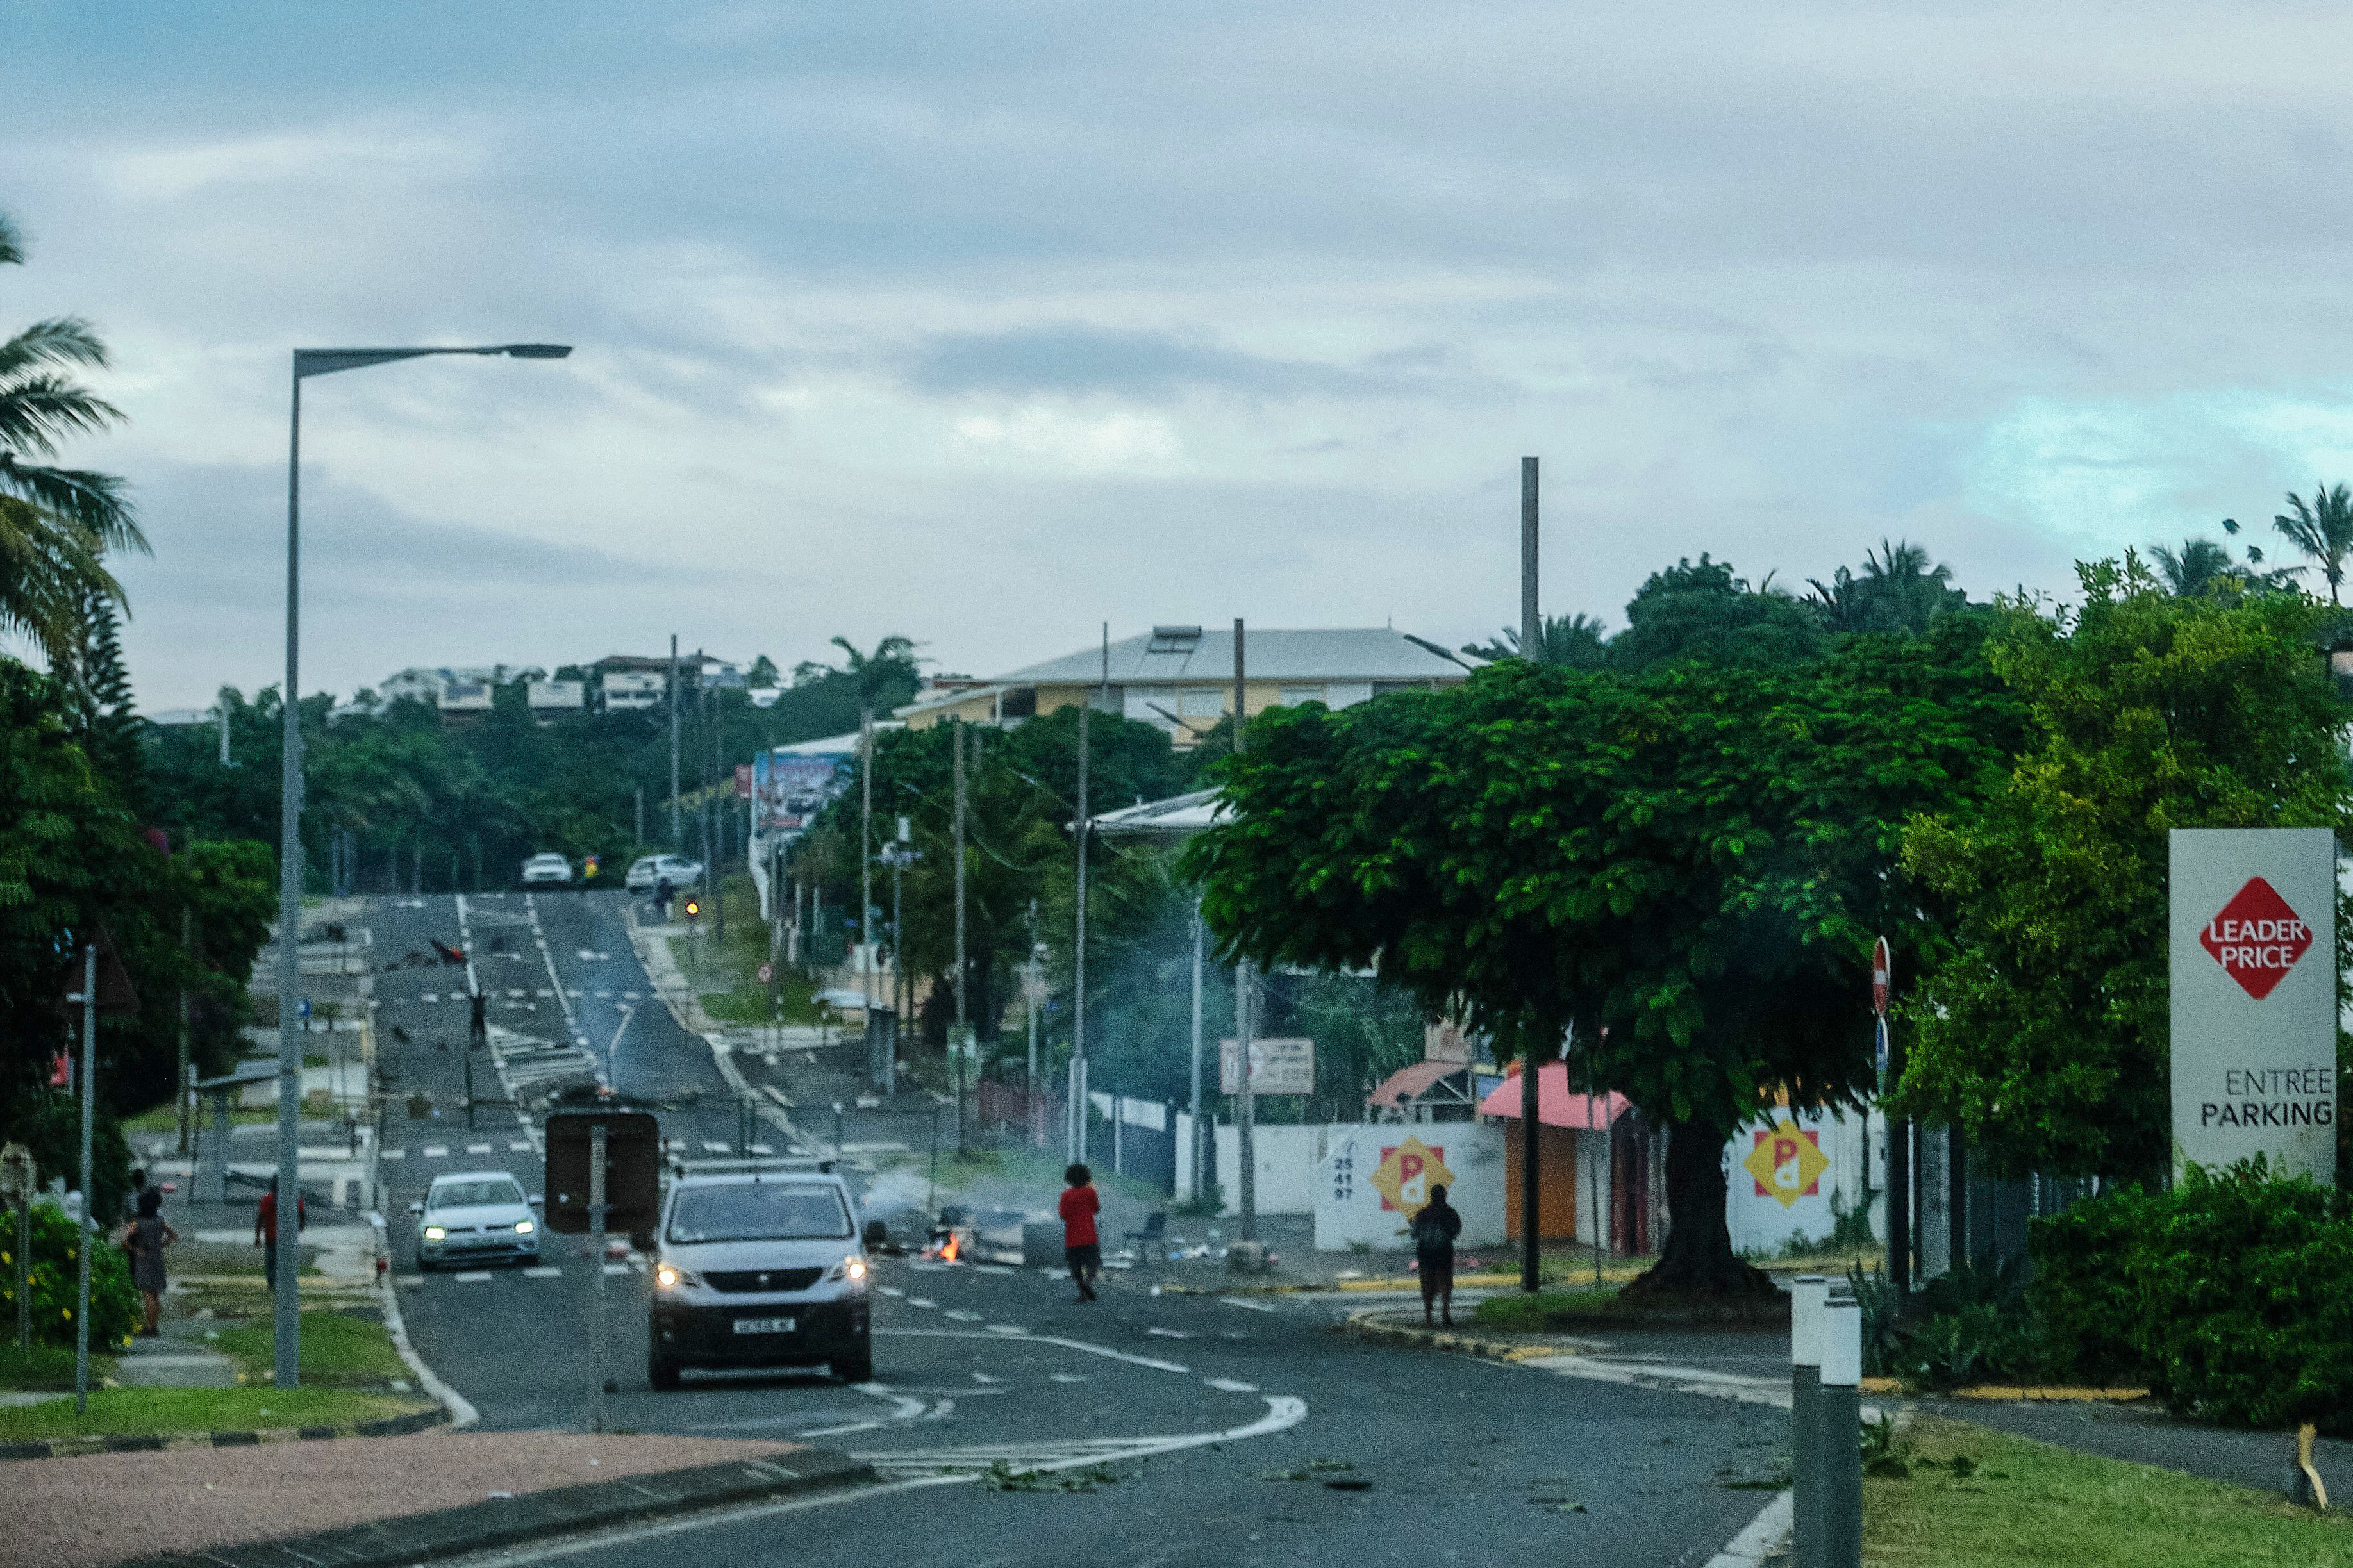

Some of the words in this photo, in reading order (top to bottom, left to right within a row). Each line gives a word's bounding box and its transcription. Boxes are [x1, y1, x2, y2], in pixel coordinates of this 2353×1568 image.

[2209, 919, 2306, 942] LEADER
[2221, 945, 2295, 969] PRICE
[2225, 1063, 2332, 1096] ENTRÉE
[2201, 1100, 2332, 1127] PARKING
